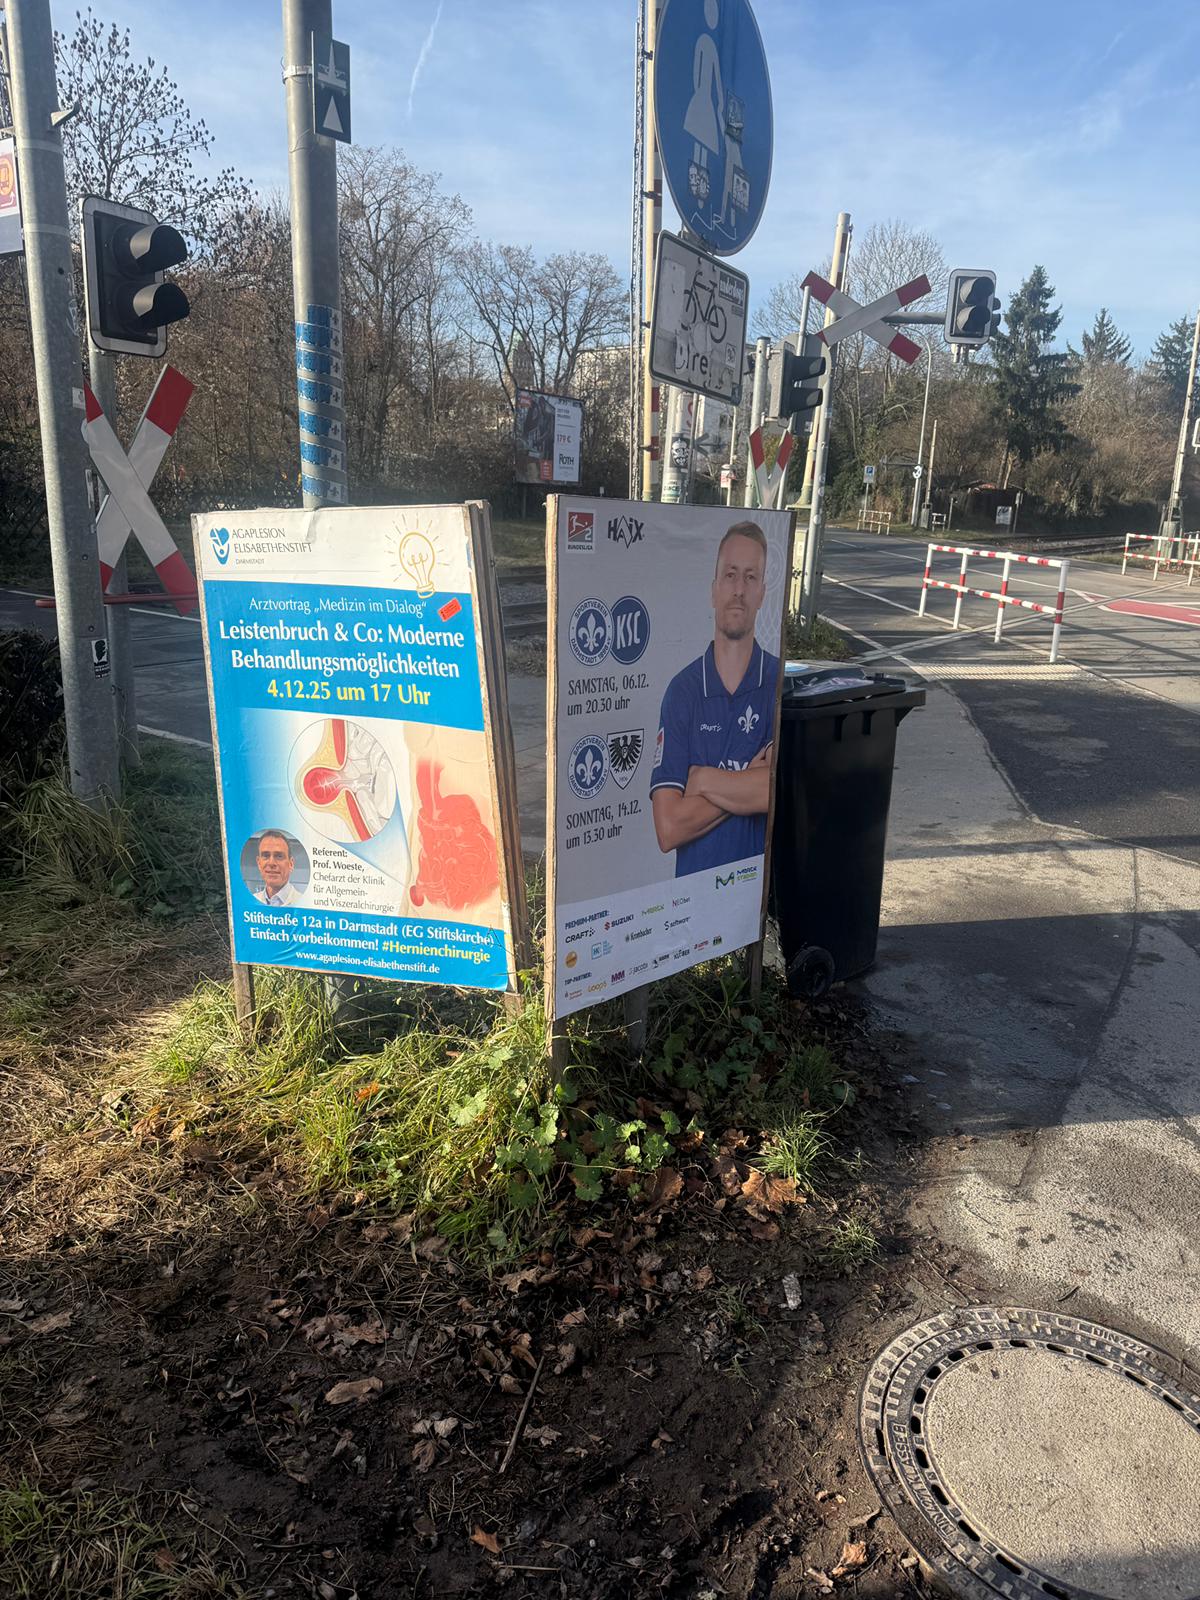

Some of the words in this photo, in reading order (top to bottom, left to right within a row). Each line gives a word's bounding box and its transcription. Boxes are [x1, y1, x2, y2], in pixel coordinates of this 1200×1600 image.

[231, 527, 286, 540] AGAPLESION
[584, 529, 593, 541] 2
[234, 542, 312, 554] ELISABETHENSTIFT
[249, 597, 310, 615] Arztvortrag
[369, 599, 383, 613] im
[219, 620, 329, 642] Leistenbruch
[333, 622, 349, 642] &
[353, 622, 384, 643] Co:
[388, 624, 465, 648] Moderne
[616, 610, 641, 650] KSC
[231, 649, 460, 679] Behandlungsmöglichkeiten
[267, 679, 331, 700] 4.12.25
[337, 685, 366, 701] um
[371, 683, 392, 702] 17
[398, 683, 432, 705] Uhr
[568, 676, 619, 696] SAMSTAG,
[622, 674, 650, 690] 06.12.
[567, 703, 583, 716] um
[585, 698, 613, 714] 20.30
[614, 696, 631, 711] uhr
[566, 805, 614, 830] SONNTAG,
[618, 799, 642, 816] 14.12.
[566, 837, 580, 849] um
[583, 827, 605, 845] 13.30
[607, 824, 623, 838] uhr
[312, 847, 348, 858] Referent:
[312, 860, 332, 870] Prof.
[333, 861, 365, 872] Woeste,
[313, 872, 346, 883] Chefarzt
[347, 874, 361, 884] der
[362, 875, 386, 886] Klinik
[313, 885, 324, 894] für
[325, 886, 369, 898] Allgemein-
[313, 897, 330, 907] und
[330, 898, 395, 914] Viszeralchirurgie
[243, 911, 299, 927] Stiftstraße
[301, 916, 323, 929] 12a
[325, 916, 336, 930] in
[339, 918, 399, 936] Darmstadt
[401, 926, 424, 940] (EG
[564, 909, 610, 930] PREMIUM-PARTNER:
[611, 914, 635, 928] SUZUKI
[250, 927, 290, 942] Einfach
[292, 933, 379, 951] vorbeikommen!
[382, 940, 491, 965] #Hernienchirurgie
[565, 930, 589, 944] CRAFT
[295, 951, 440, 974] www.agaplesion-elisabethenstift.de
[564, 972, 593, 986] TOP-PARTNER:
